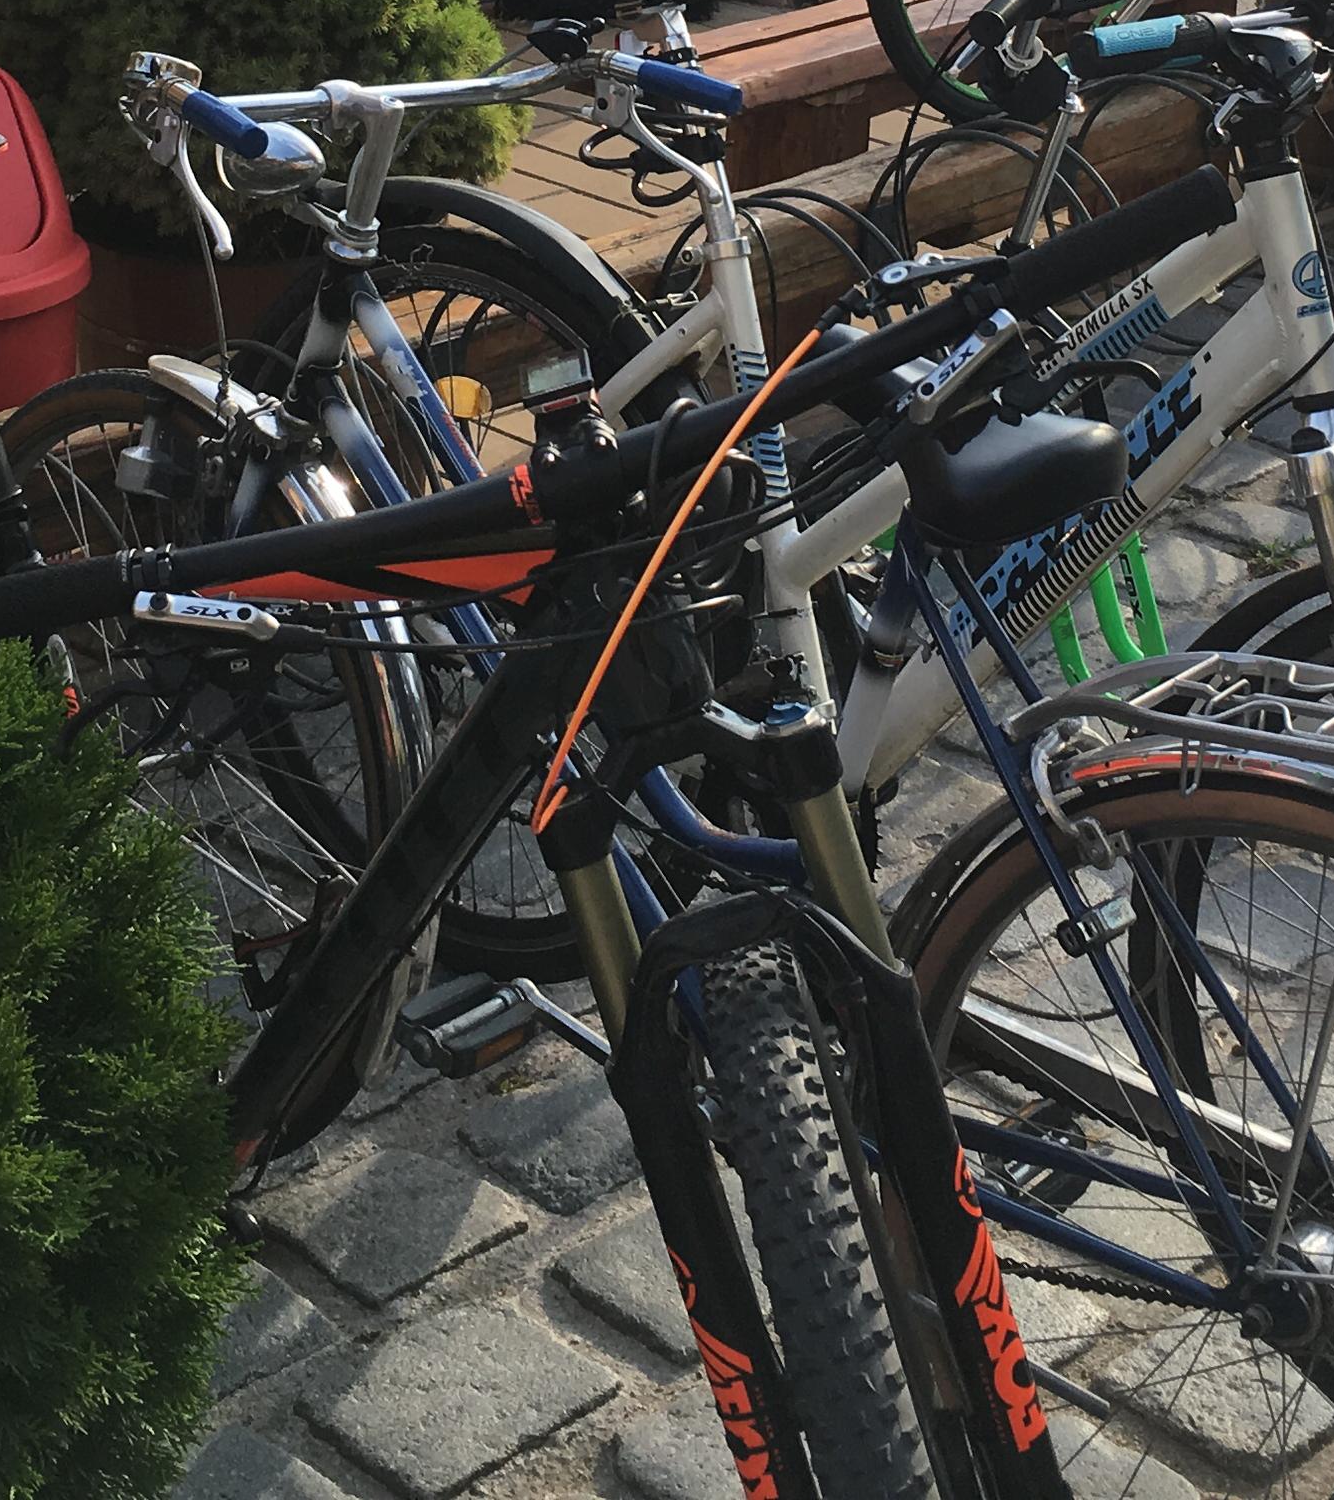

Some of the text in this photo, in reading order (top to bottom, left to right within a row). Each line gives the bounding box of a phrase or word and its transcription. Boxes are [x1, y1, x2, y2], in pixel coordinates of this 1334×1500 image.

[1117, 26, 1157, 40] ONE
[1059, 273, 1154, 358] ORMULA SX
[938, 345, 974, 386] SLX
[181, 605, 233, 620] SLX
